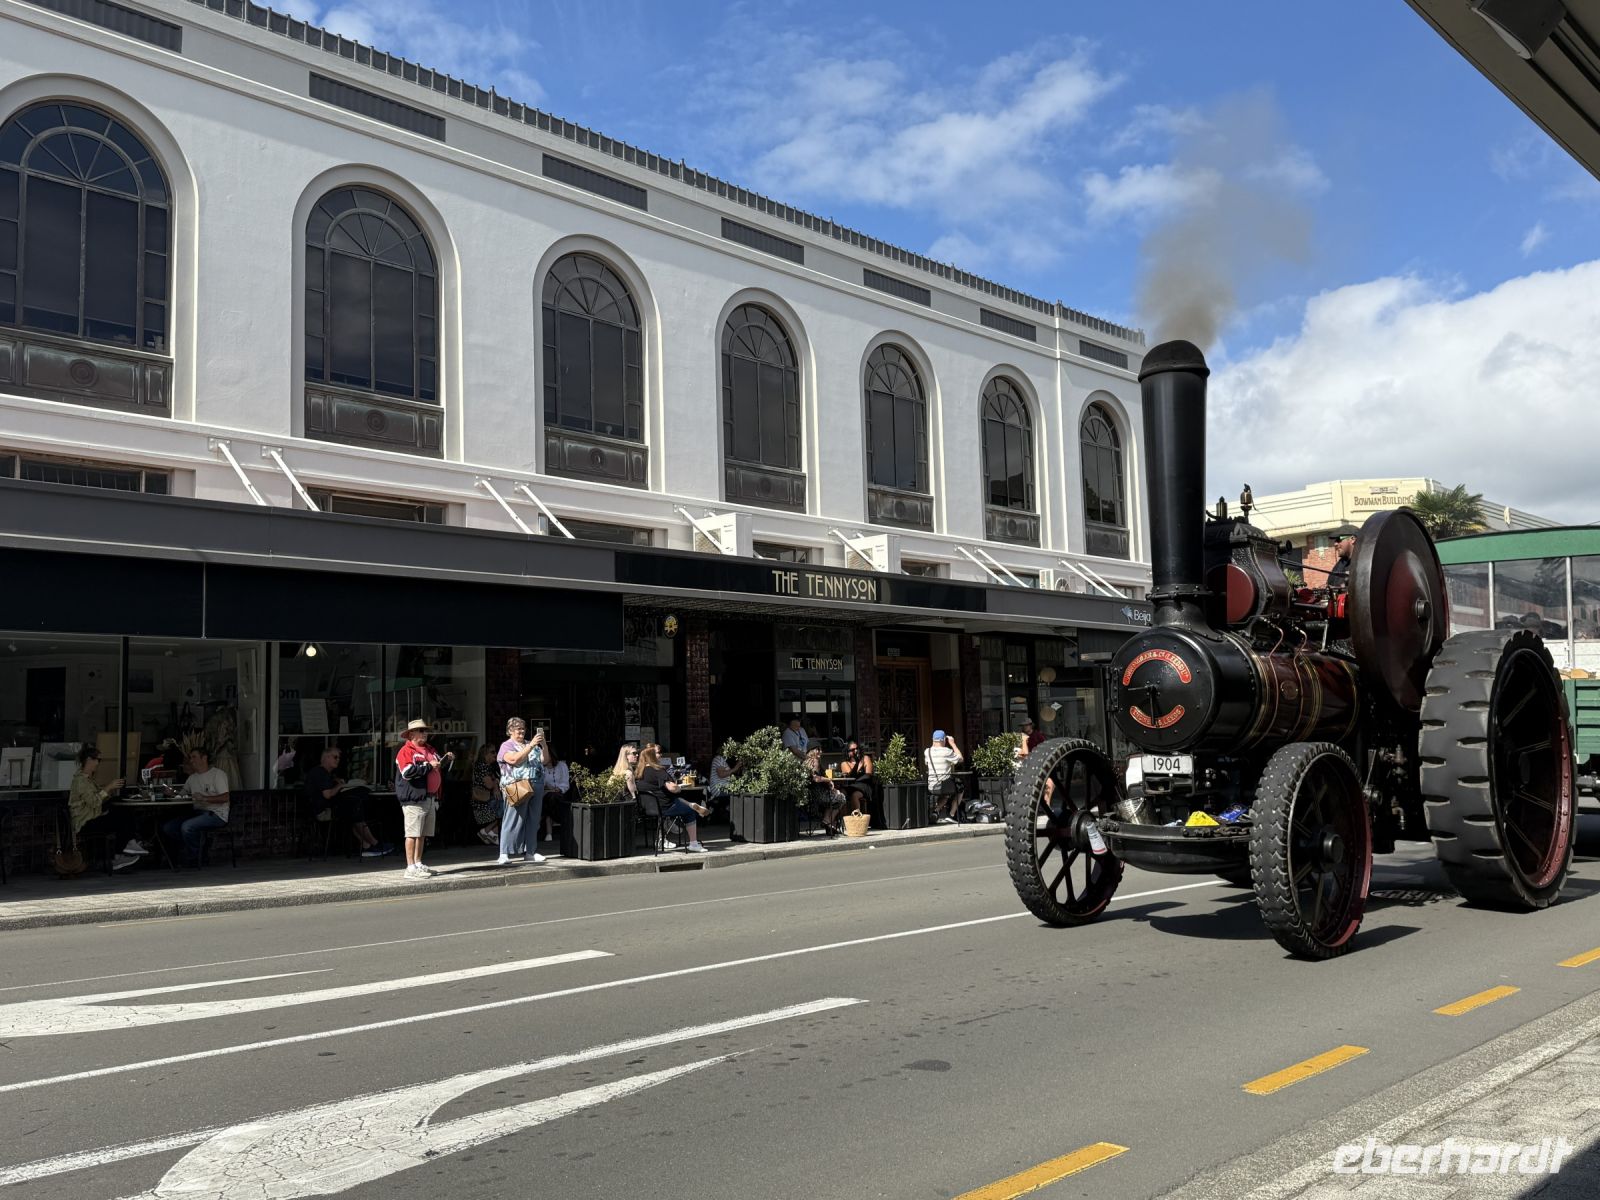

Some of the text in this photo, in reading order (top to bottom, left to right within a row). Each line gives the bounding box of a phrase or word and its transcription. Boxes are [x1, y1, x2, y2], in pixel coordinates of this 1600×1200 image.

[1353, 496, 1382, 506] BOWMAN
[772, 570, 877, 601] THE TENNYSON
[789, 657, 843, 670] THE TENNYSON
[1153, 757, 1181, 772] 1904
